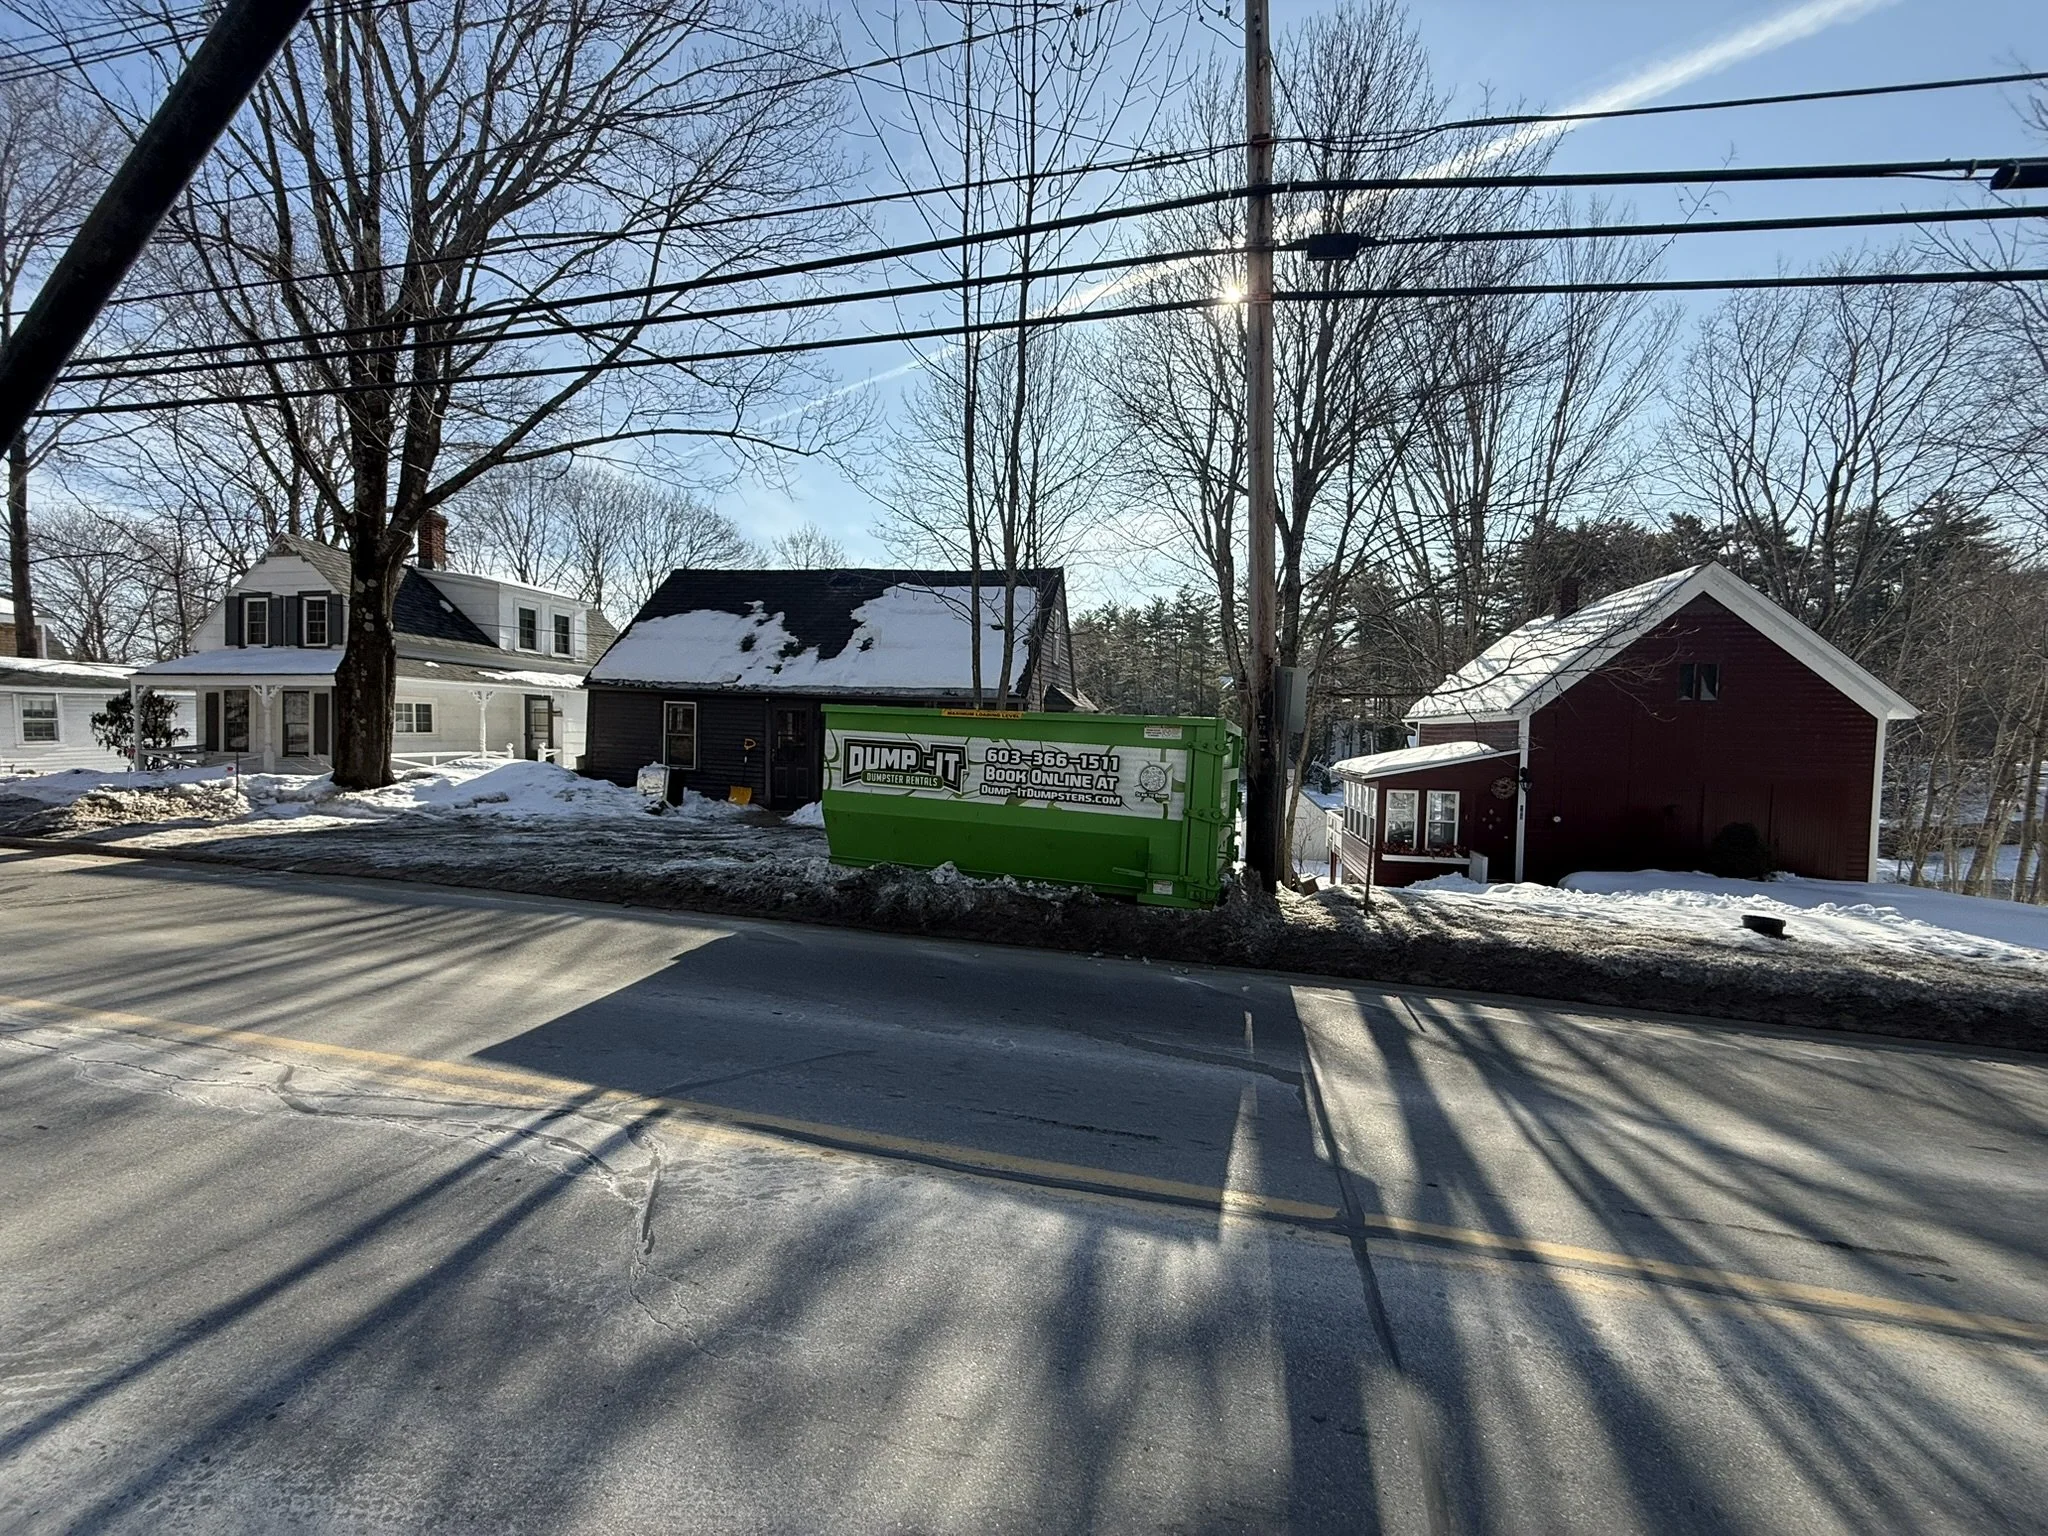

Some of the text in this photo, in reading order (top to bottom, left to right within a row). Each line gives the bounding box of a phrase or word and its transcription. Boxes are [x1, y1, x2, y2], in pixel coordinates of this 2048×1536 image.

[849, 745, 960, 782] DUMP-IT
[986, 749, 1119, 772] 603-366-1511
[866, 772, 938, 787] DUMPSTER RENTALS
[985, 766, 1118, 790] BOOK ONLINE AT
